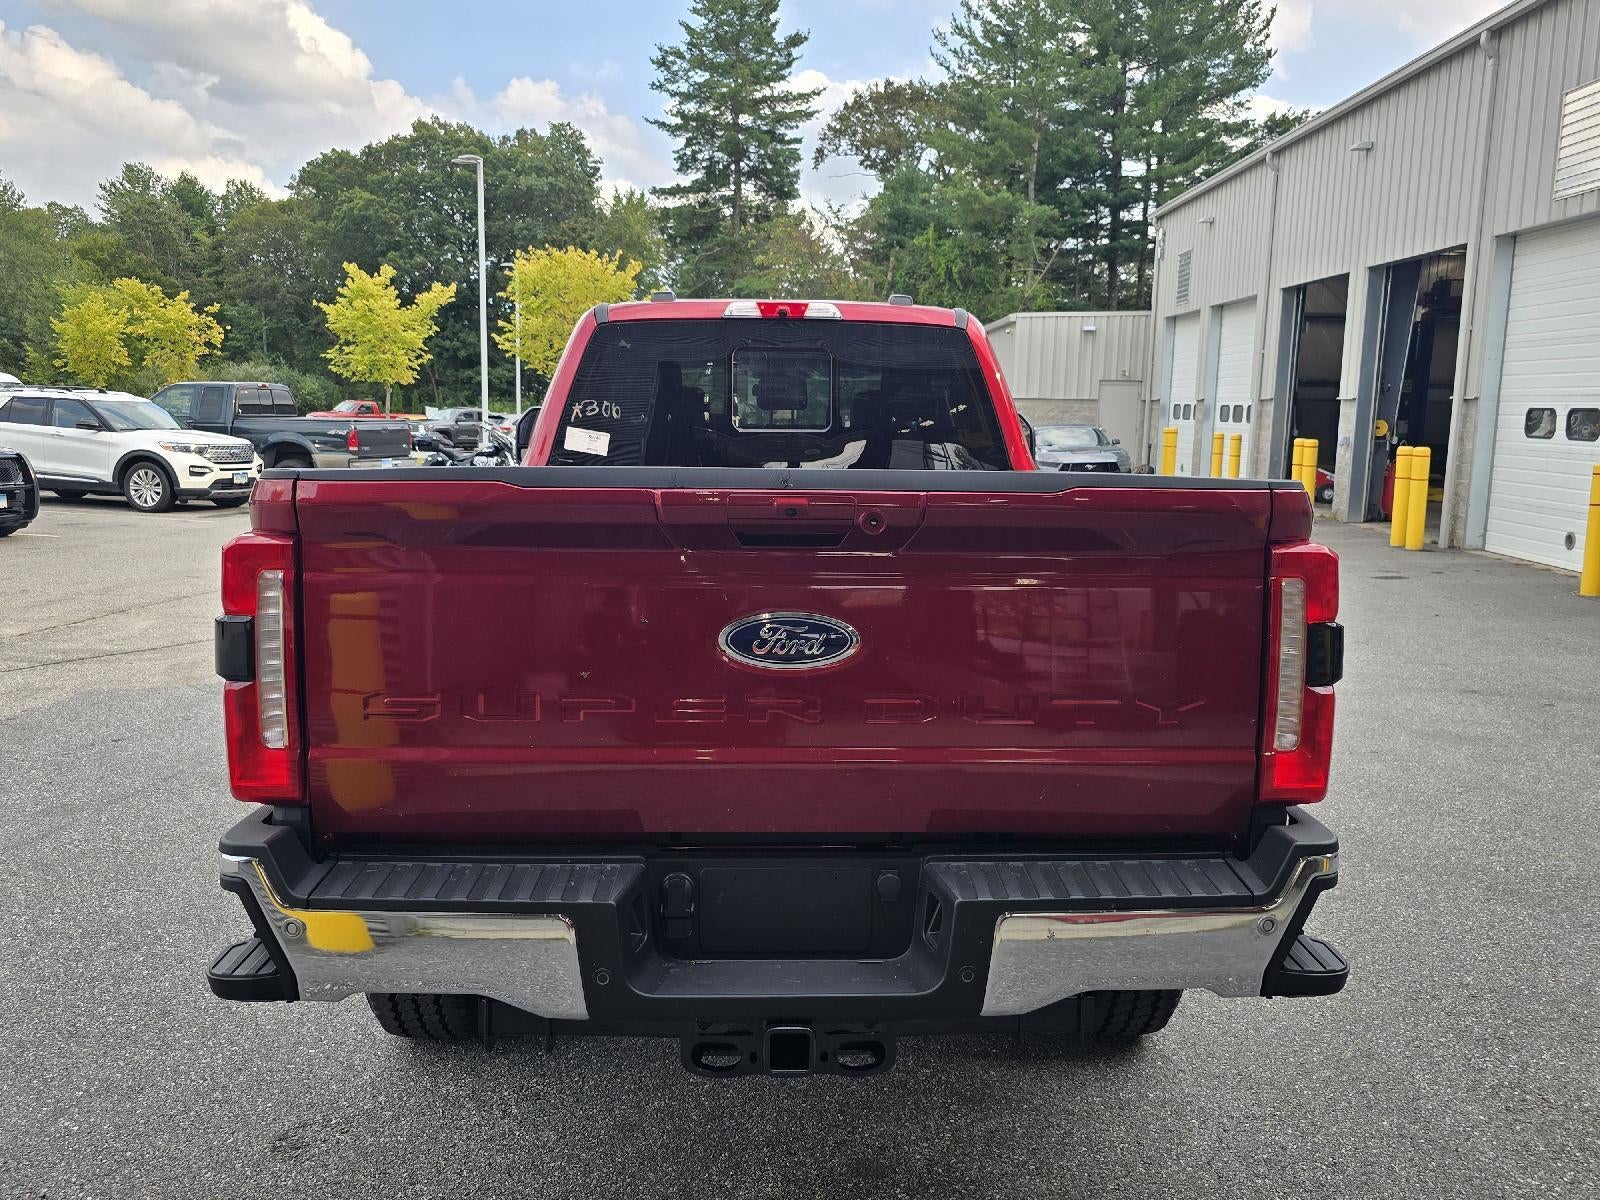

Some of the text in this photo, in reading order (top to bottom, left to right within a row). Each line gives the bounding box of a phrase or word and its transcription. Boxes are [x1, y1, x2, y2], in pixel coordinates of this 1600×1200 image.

[751, 623, 827, 655] Ford
[363, 694, 1206, 724] SUPER DUTY
